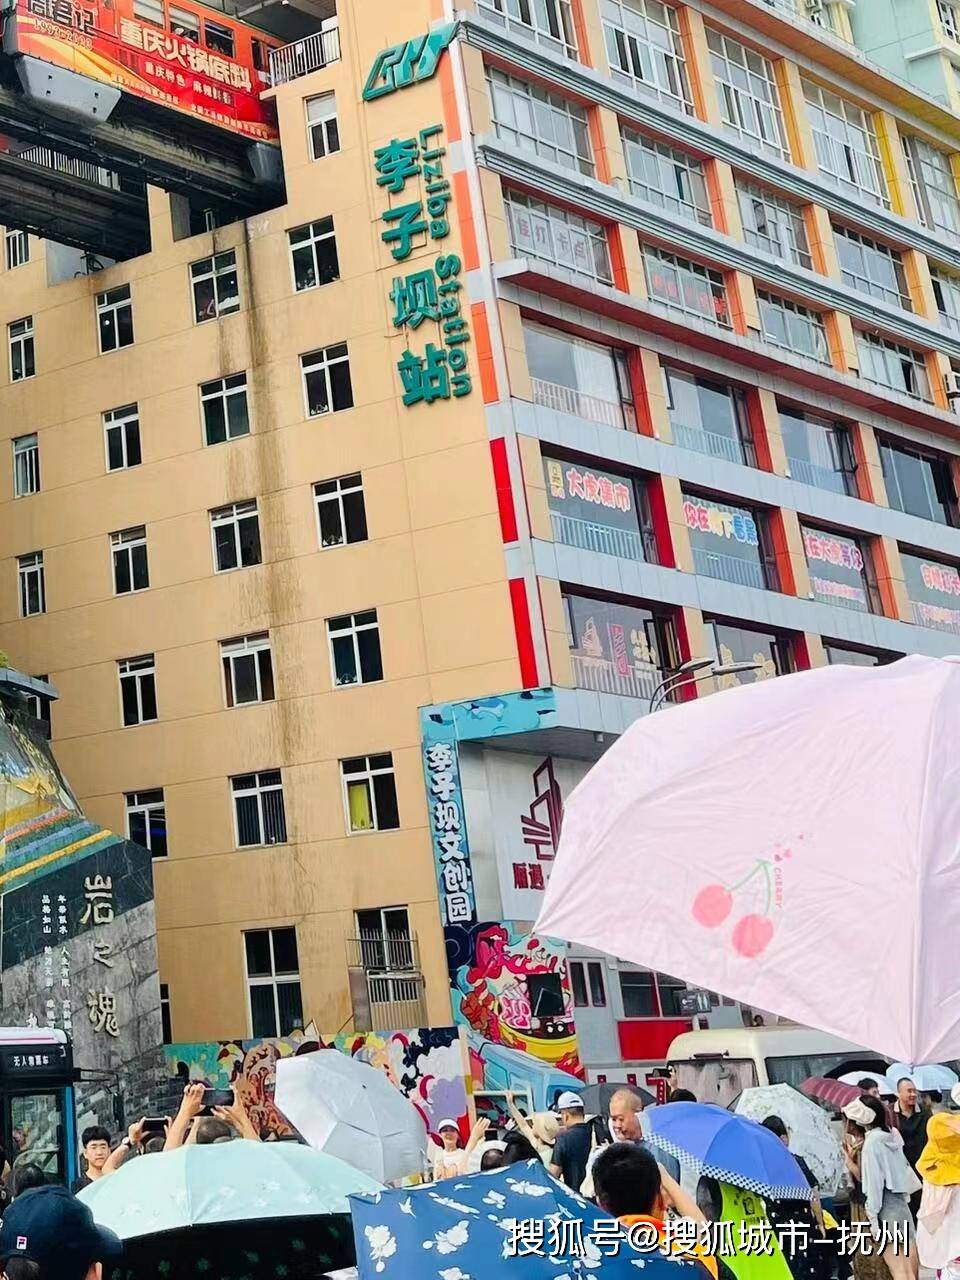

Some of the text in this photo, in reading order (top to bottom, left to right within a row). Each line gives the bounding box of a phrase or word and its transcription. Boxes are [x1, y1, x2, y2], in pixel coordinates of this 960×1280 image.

[120, 18, 252, 93] 重庆火锅底料
[374, 138, 451, 407] 李子坝站
[419, 124, 472, 398] Liziba Station
[427, 742, 472, 924] 李子坝文创园
[774, 867, 783, 908] CHERRY
[80, 874, 120, 1037] 岩之魂
